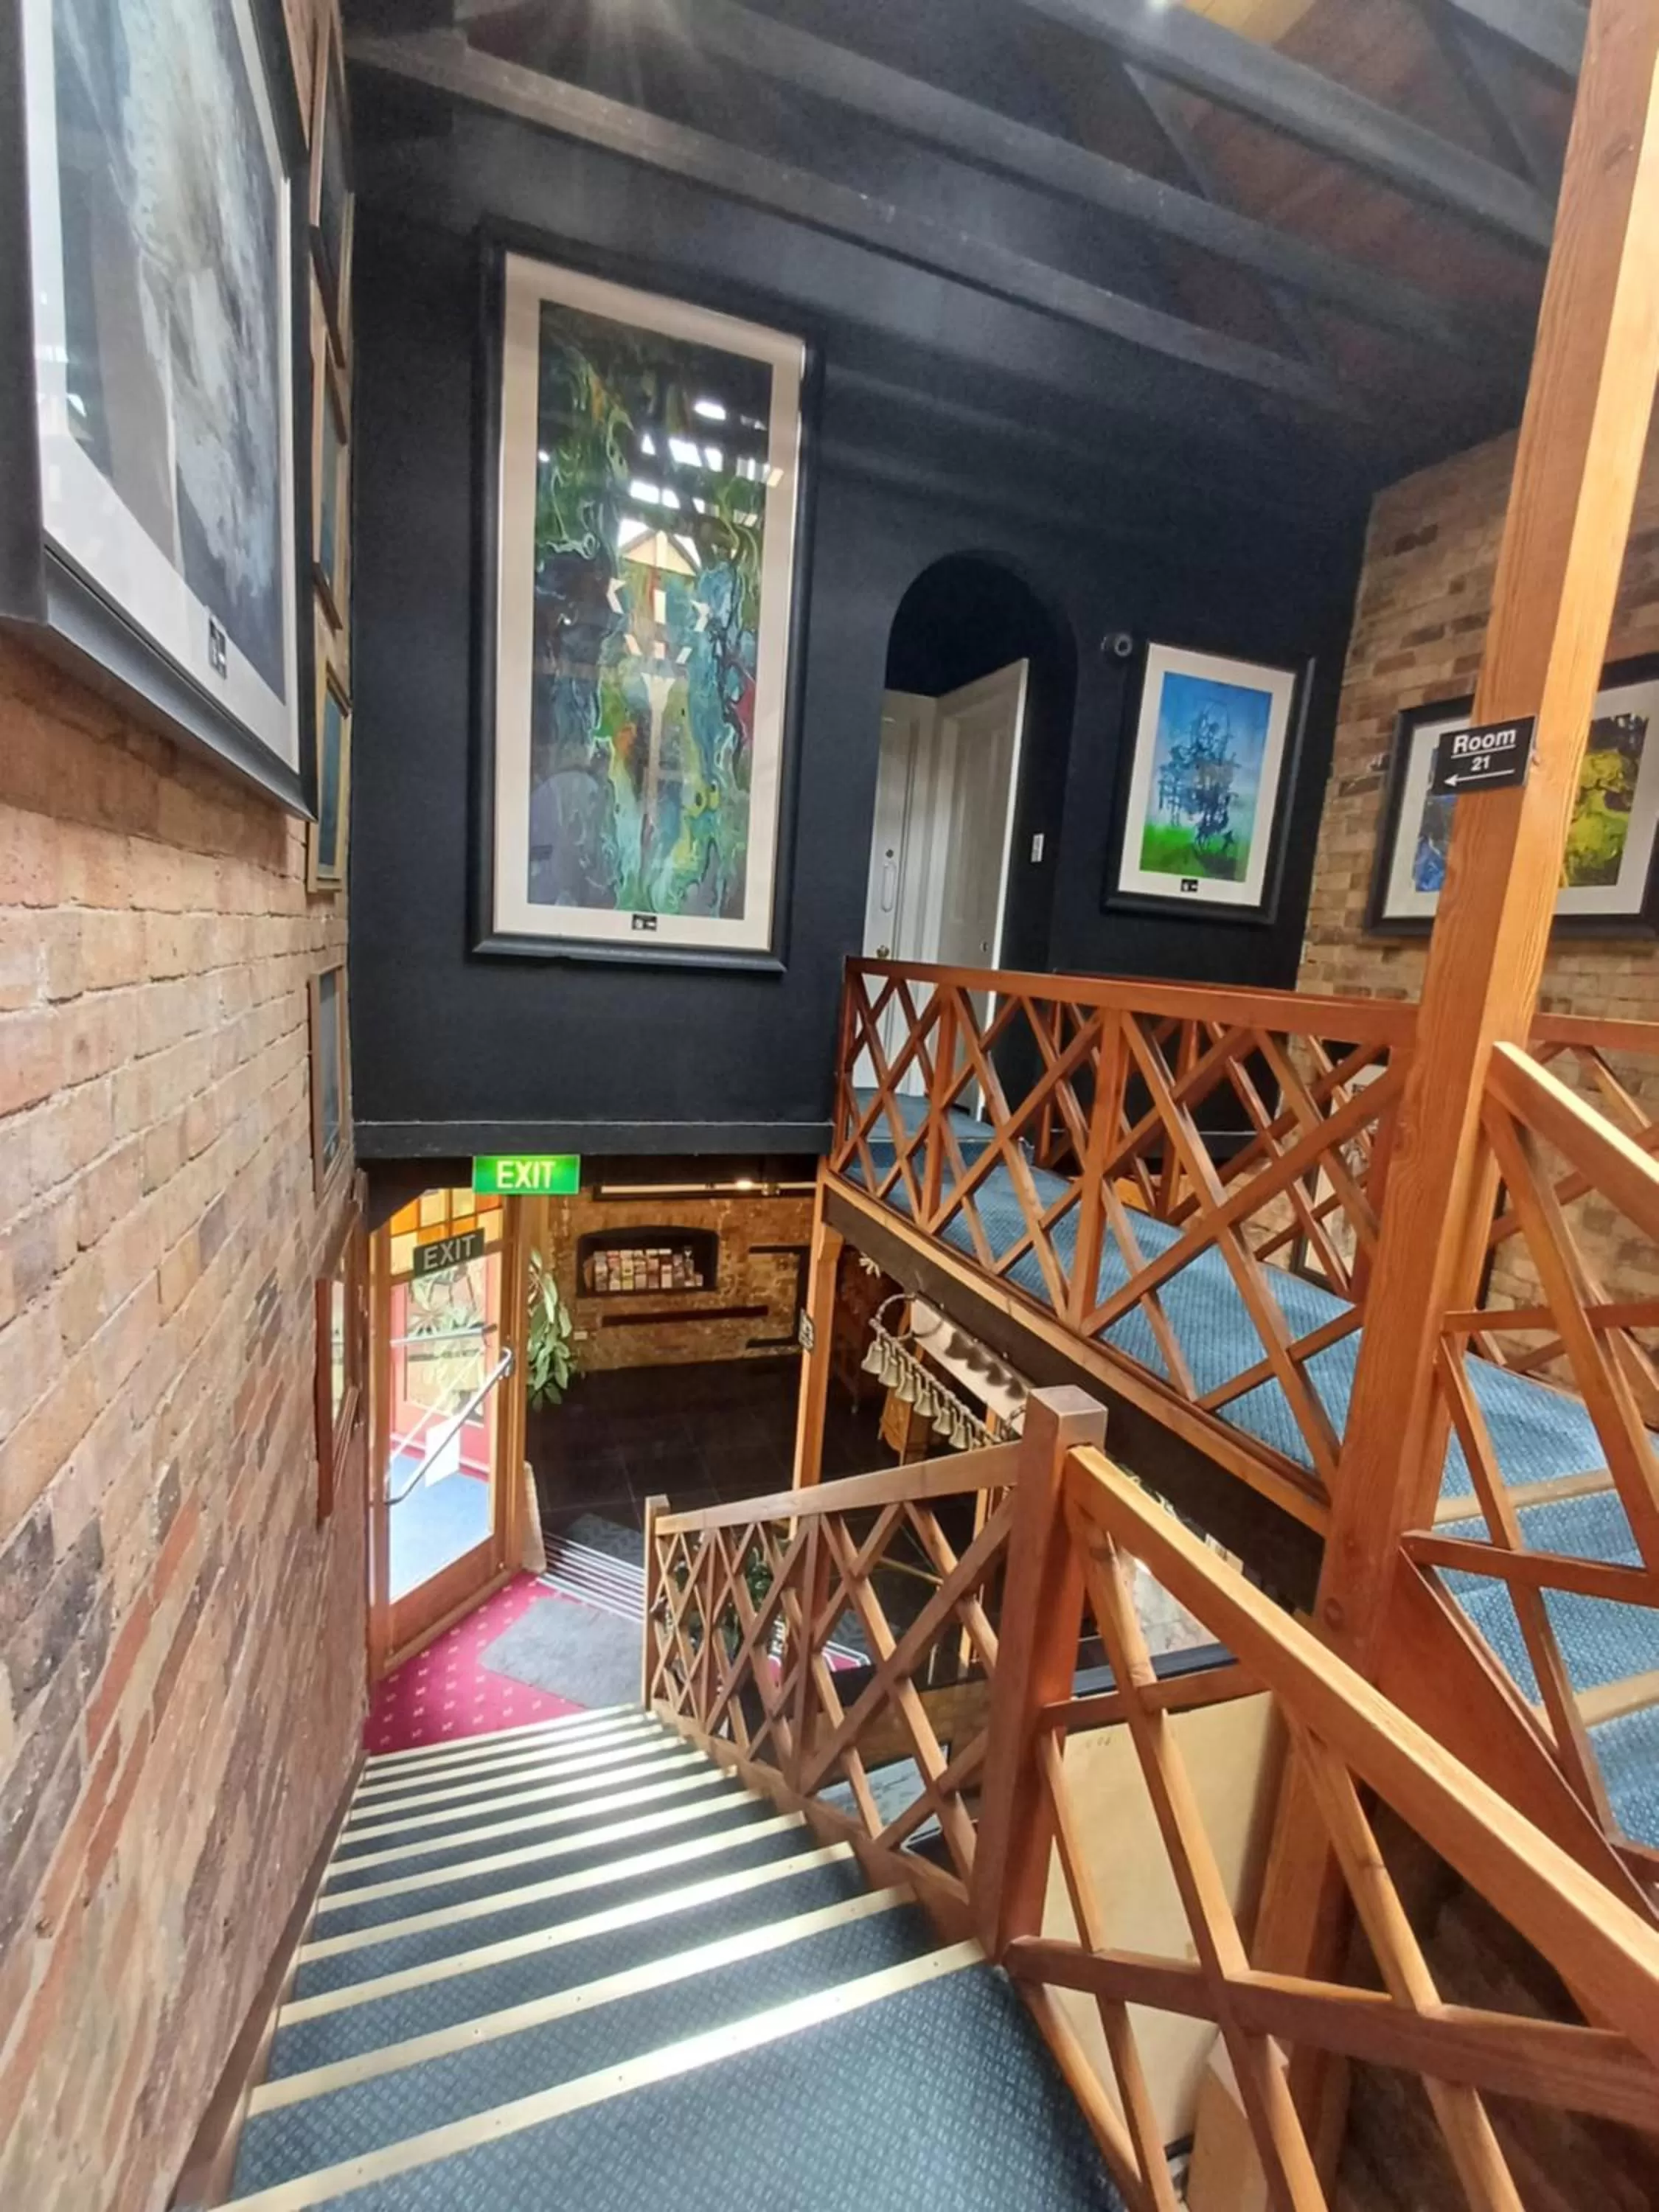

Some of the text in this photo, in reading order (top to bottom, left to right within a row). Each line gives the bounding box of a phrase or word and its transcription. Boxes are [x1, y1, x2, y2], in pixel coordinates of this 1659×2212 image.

[1453, 729, 1516, 754] Room
[1471, 755, 1491, 771] 21
[496, 1161, 556, 1189] EXIT
[423, 1235, 476, 1270] EXIT
